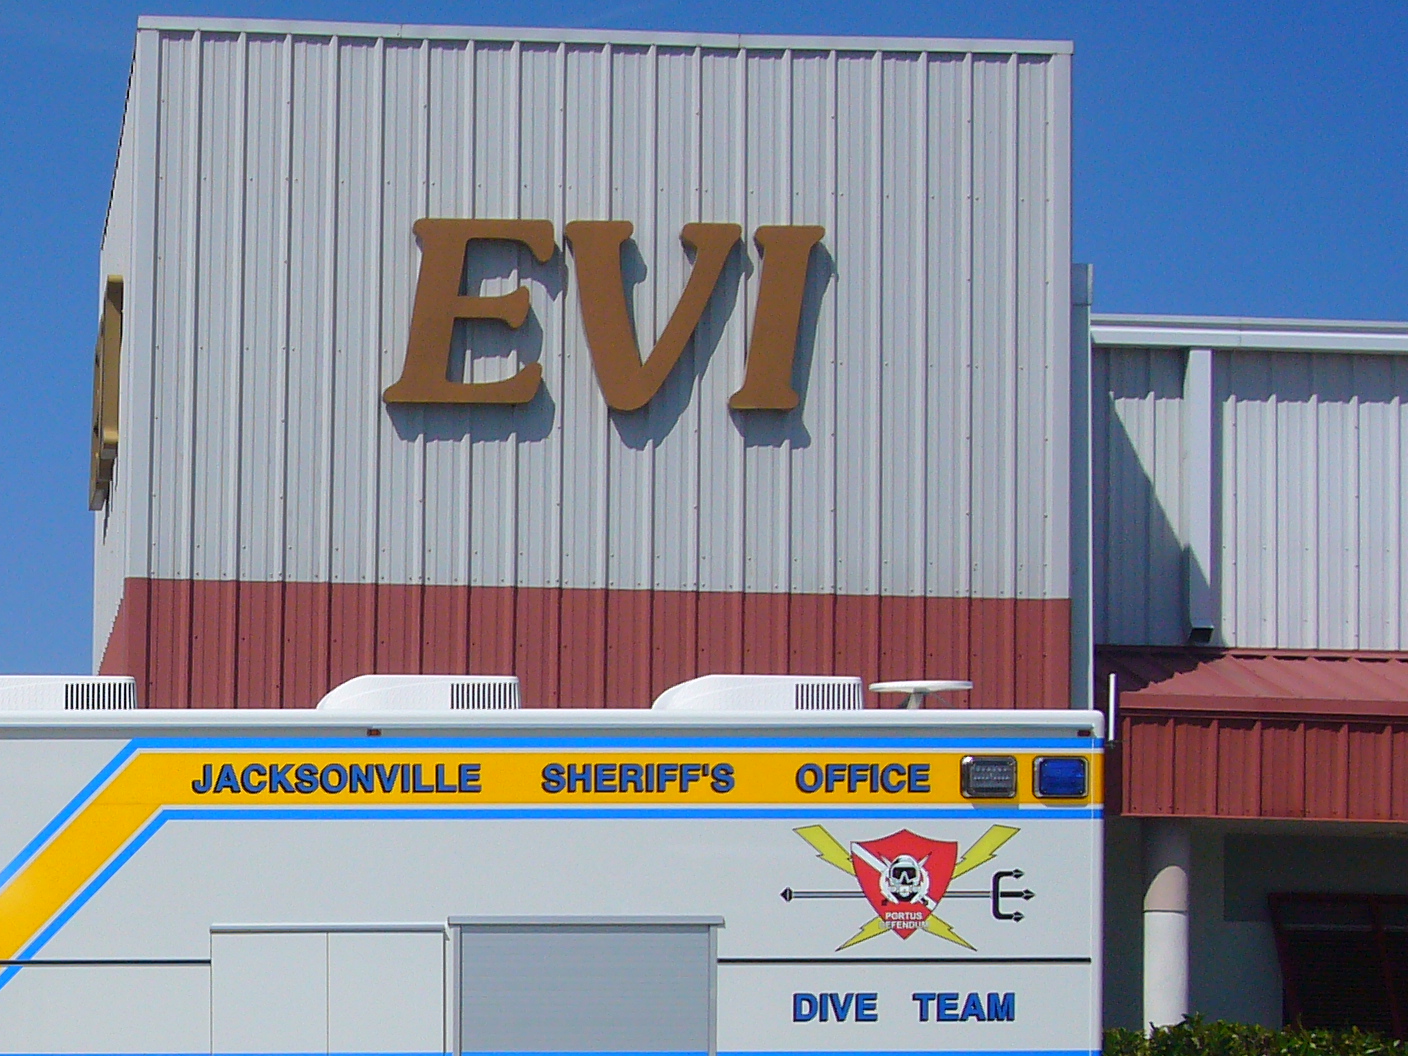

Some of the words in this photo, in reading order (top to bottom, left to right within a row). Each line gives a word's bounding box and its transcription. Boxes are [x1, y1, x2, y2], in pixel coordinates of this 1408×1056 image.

[382, 218, 826, 411] EVI
[192, 762, 482, 794] JACKSONVILLE
[540, 762, 736, 794] SHERIFF'S
[795, 762, 931, 794] OFFICE
[885, 911, 923, 920] PORTUS
[792, 992, 878, 1022] DIVE
[912, 992, 1015, 1022] TEAM
